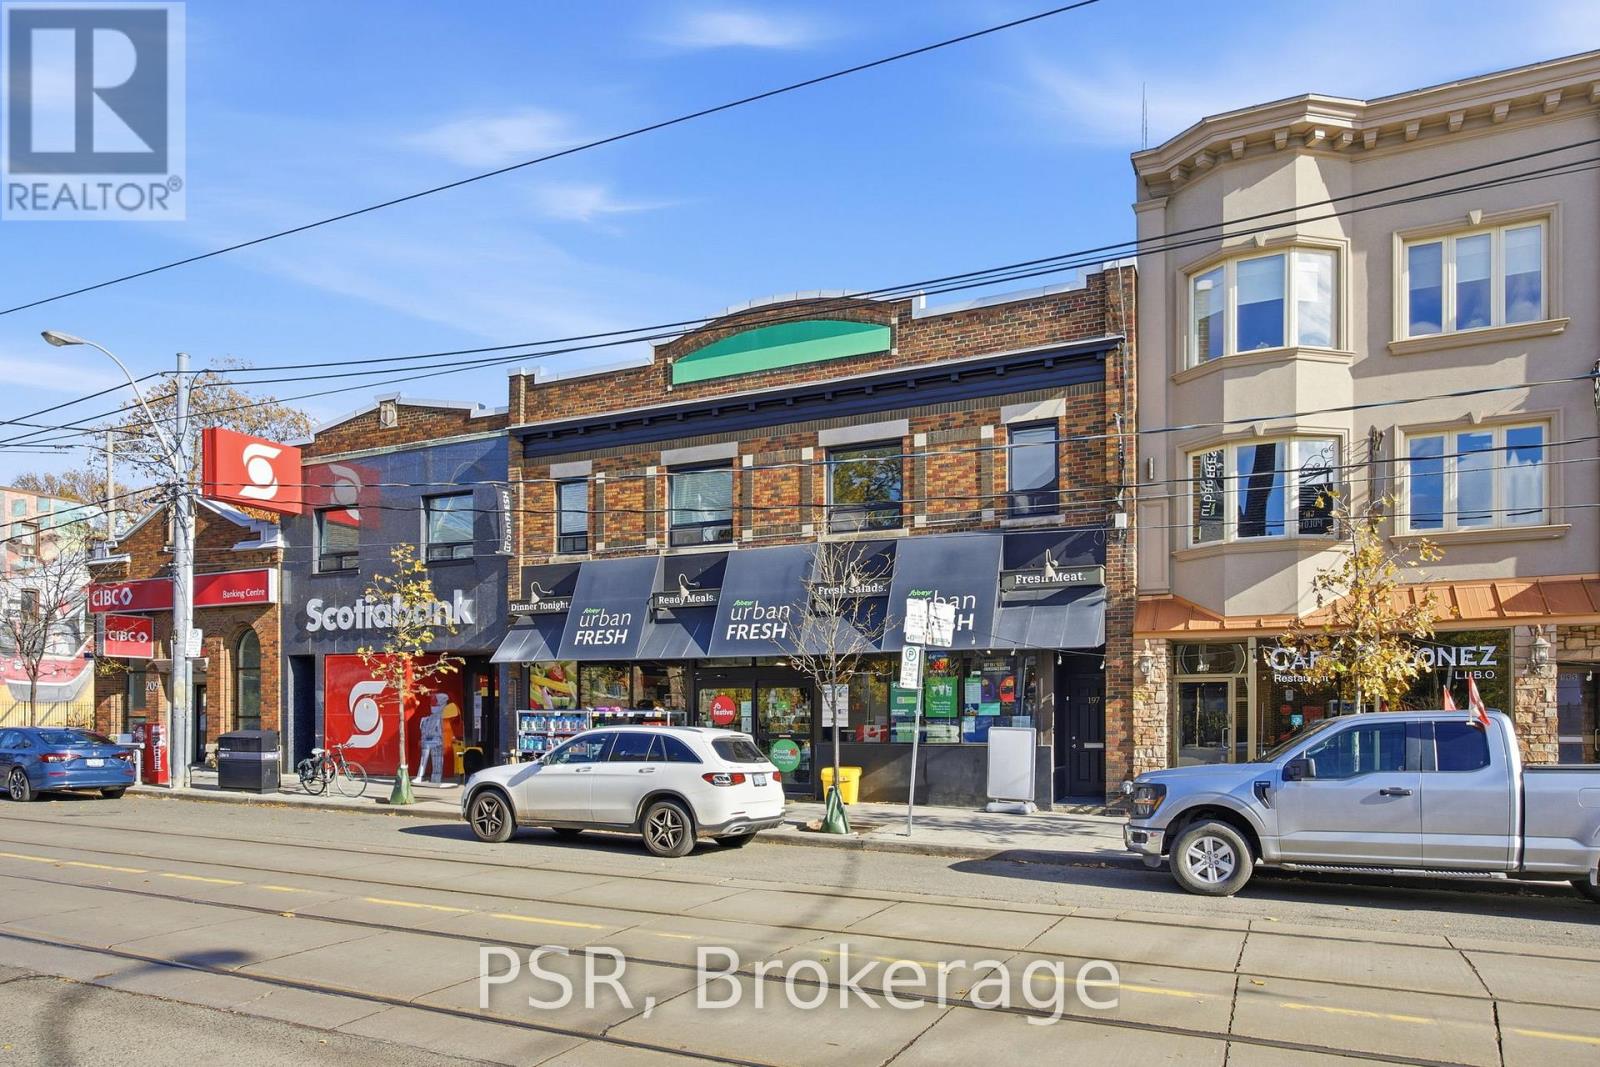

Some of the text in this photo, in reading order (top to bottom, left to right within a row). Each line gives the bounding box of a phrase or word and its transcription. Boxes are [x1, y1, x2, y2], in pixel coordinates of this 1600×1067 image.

[1015, 572, 1087, 585] Fresh Meat.
[92, 590, 120, 607] CIBC
[222, 588, 265, 600] Banking Centre
[659, 593, 717, 606] Ready Meals.
[305, 589, 475, 633] Scotiabank
[511, 600, 571, 612] Dinner Tonight.
[730, 600, 791, 621] urban
[579, 608, 632, 628] urban
[108, 630, 137, 642] CIBC
[574, 629, 629, 645] FRESH
[725, 622, 788, 641] FRESH
[1270, 647, 1342, 671] CAF
[146, 680, 160, 692] 209
[1088, 696, 1100, 704] 197
